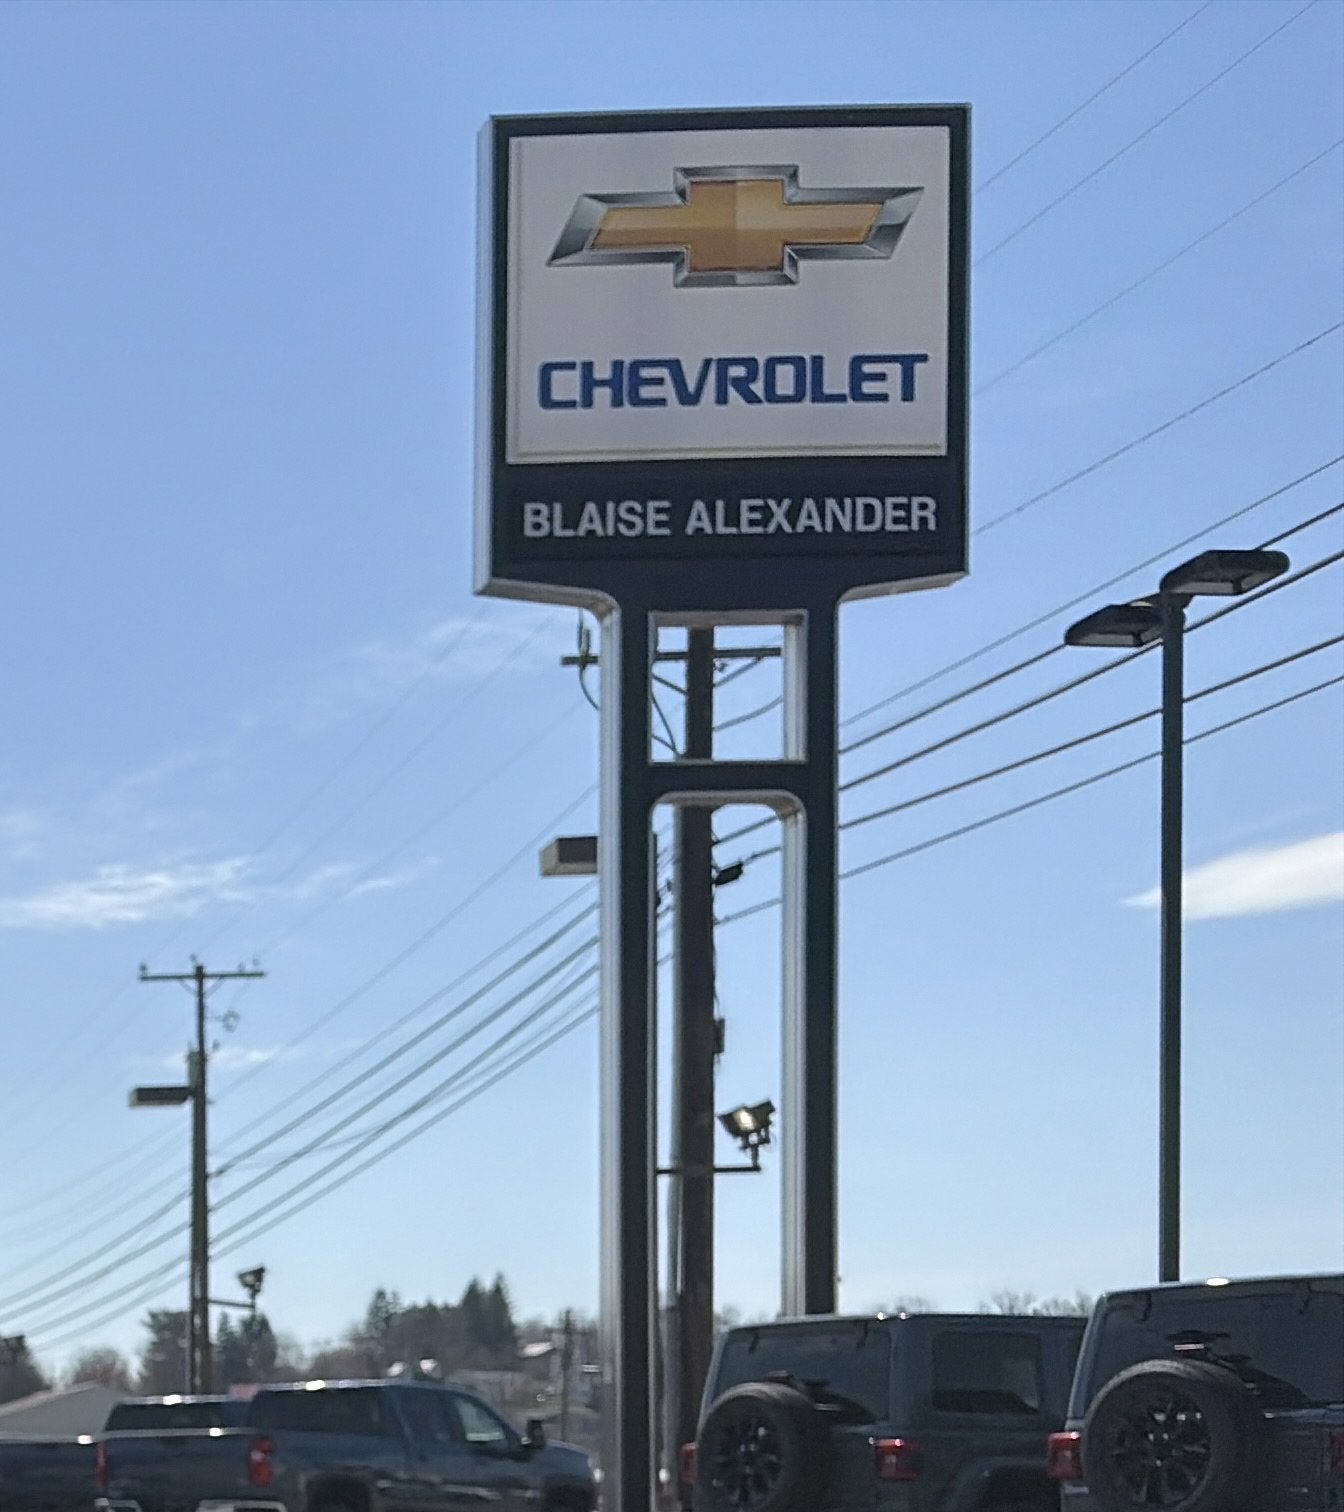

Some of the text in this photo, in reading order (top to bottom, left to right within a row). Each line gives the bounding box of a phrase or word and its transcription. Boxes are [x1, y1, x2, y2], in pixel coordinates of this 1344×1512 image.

[537, 353, 929, 410] CHEVROLET
[522, 496, 938, 538] BLAISE ALEXANDER
